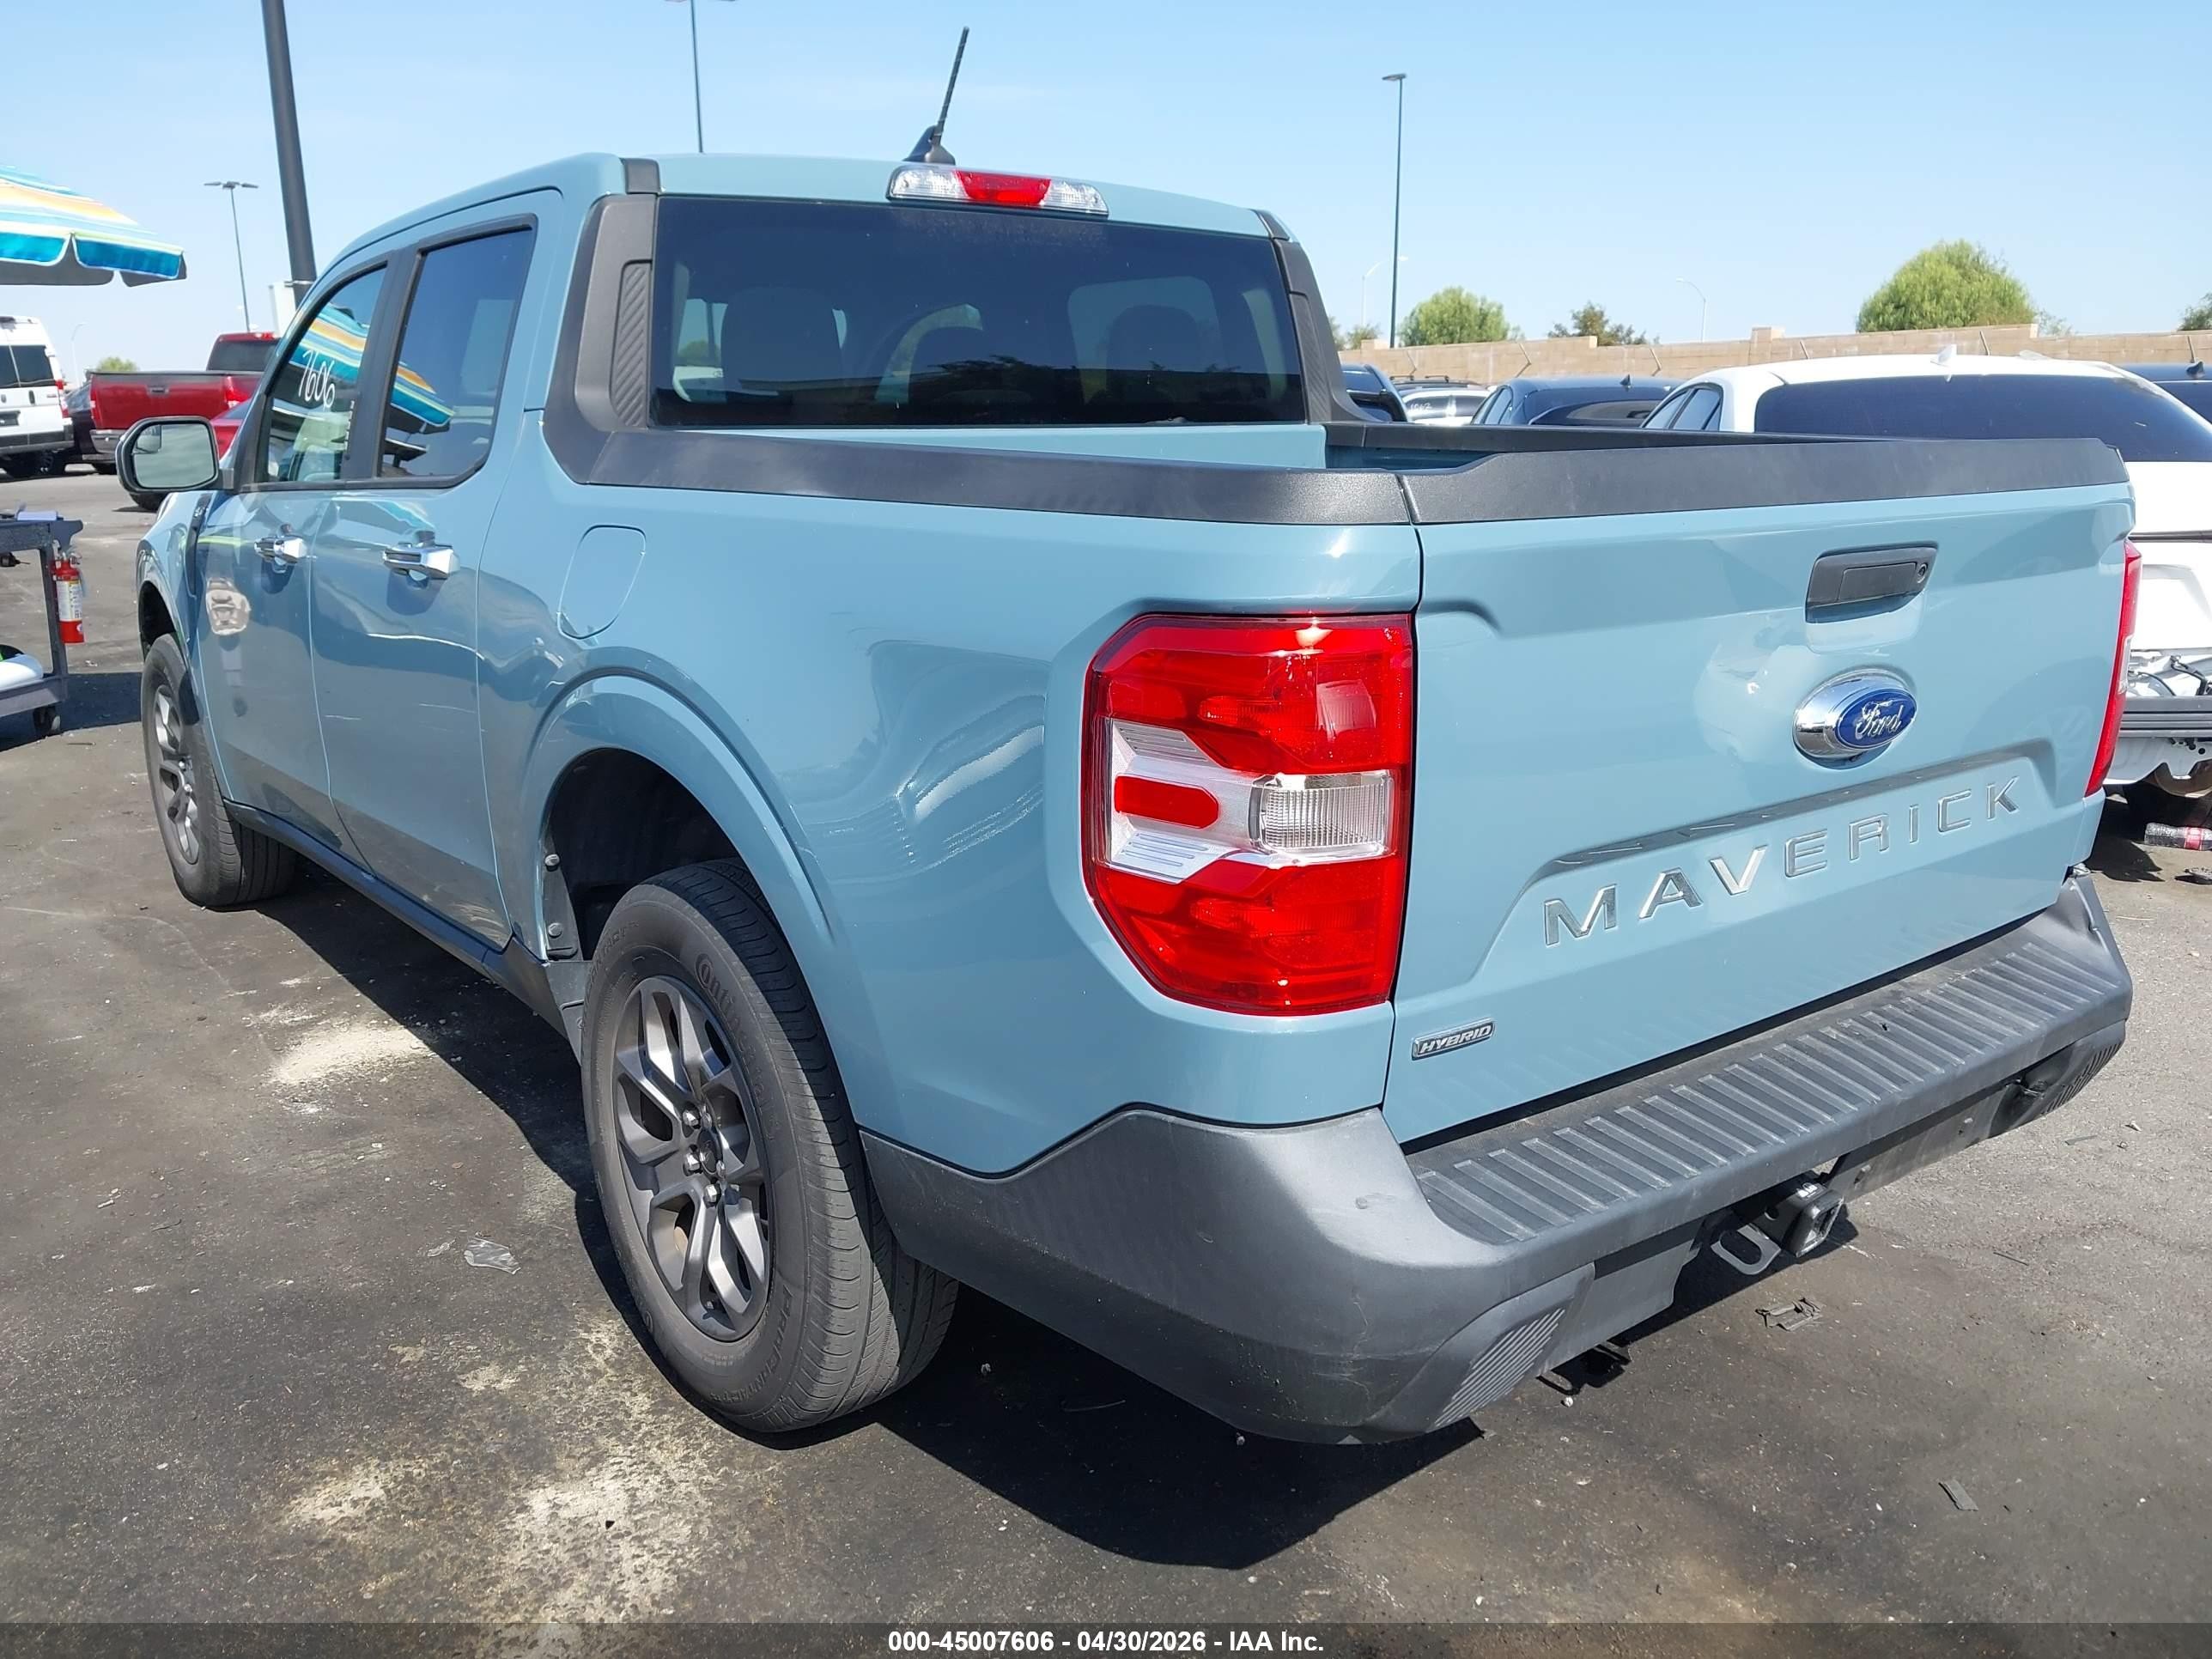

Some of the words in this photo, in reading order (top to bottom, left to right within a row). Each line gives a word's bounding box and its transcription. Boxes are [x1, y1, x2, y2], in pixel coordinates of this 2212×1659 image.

[298, 349, 336, 412] 7606
[1855, 698, 1905, 740] Ford
[1545, 775, 2020, 945] MAVERICK
[1419, 1024, 1492, 1054] HYBRID
